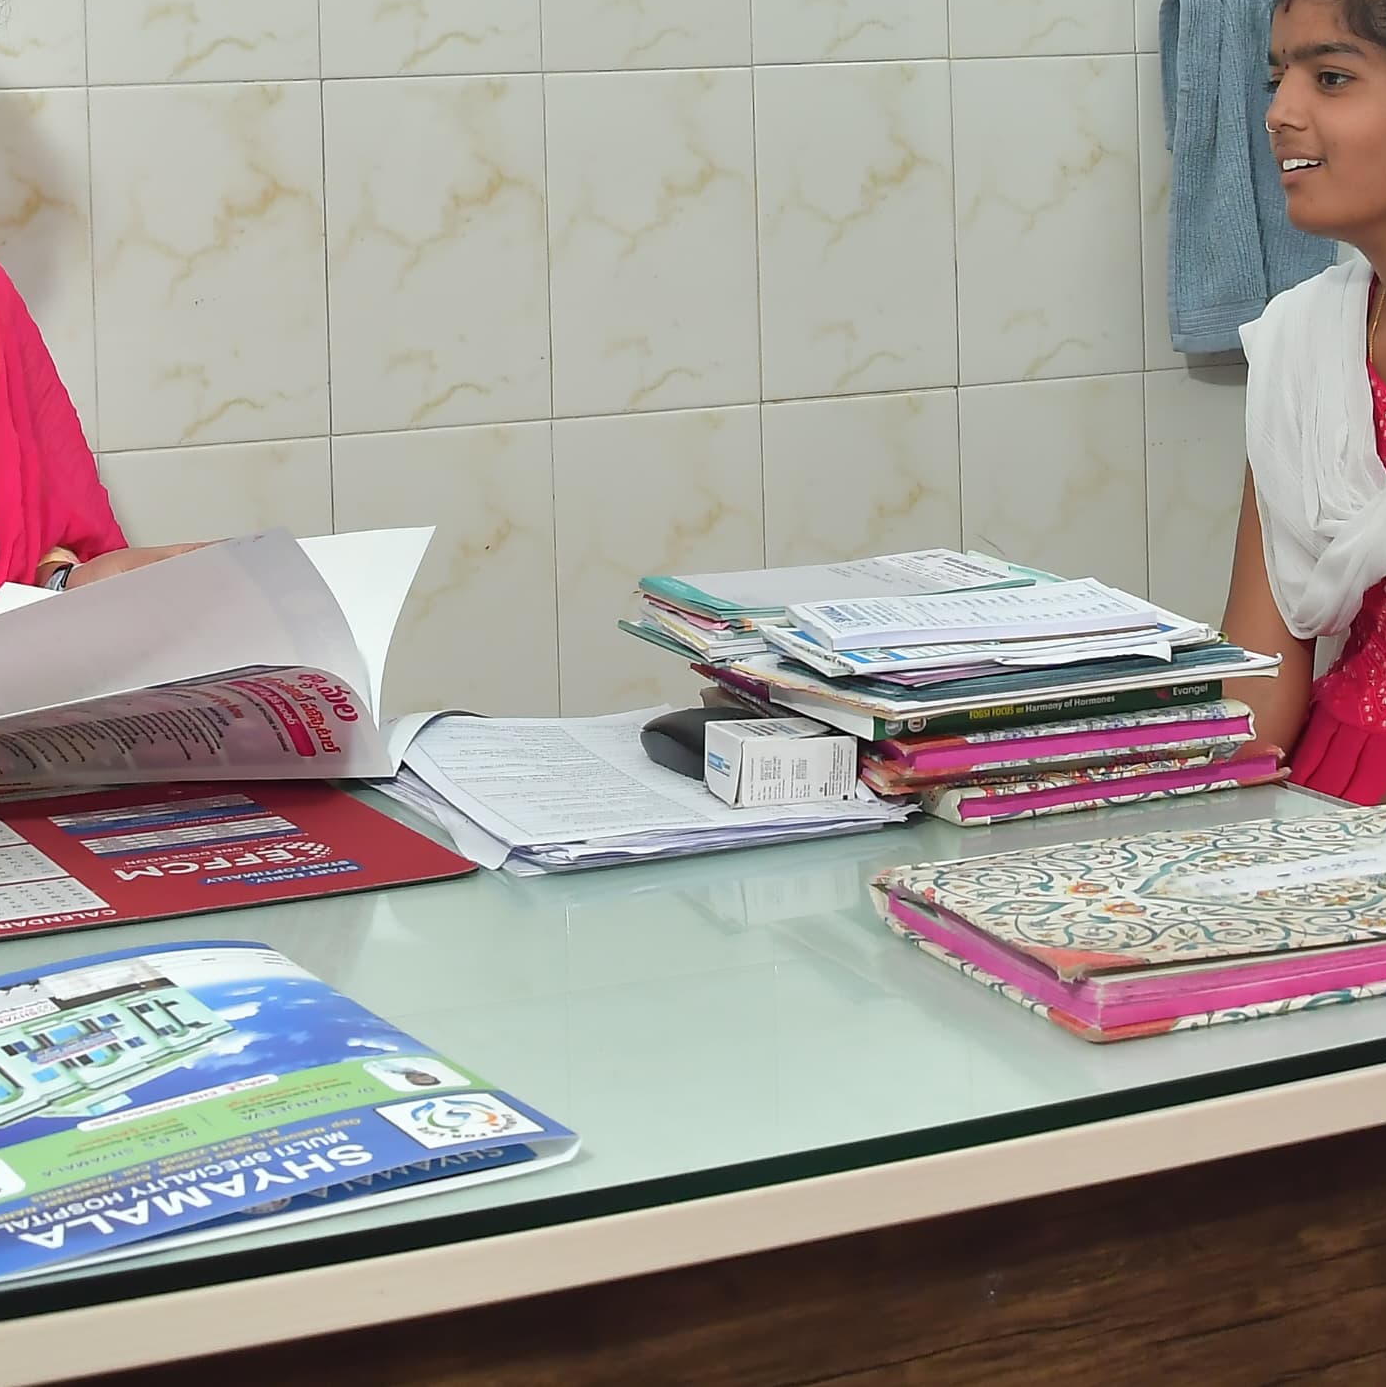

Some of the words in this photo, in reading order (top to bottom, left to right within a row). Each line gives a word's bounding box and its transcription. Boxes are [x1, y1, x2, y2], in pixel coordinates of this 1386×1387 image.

[1173, 683, 1208, 696] Evangel
[970, 709, 990, 719] FOGSI
[991, 707, 1013, 717] FOCUS
[1025, 701, 1062, 713] Harmony
[1064, 699, 1073, 708] of
[1074, 695, 1115, 706] Hormones
[205, 867, 296, 884] OPTIMALLY
[283, 1131, 348, 1155] MULTI
[131, 1149, 275, 1199] SPECIALITY
[18, 1143, 374, 1249] SHYAMALA
